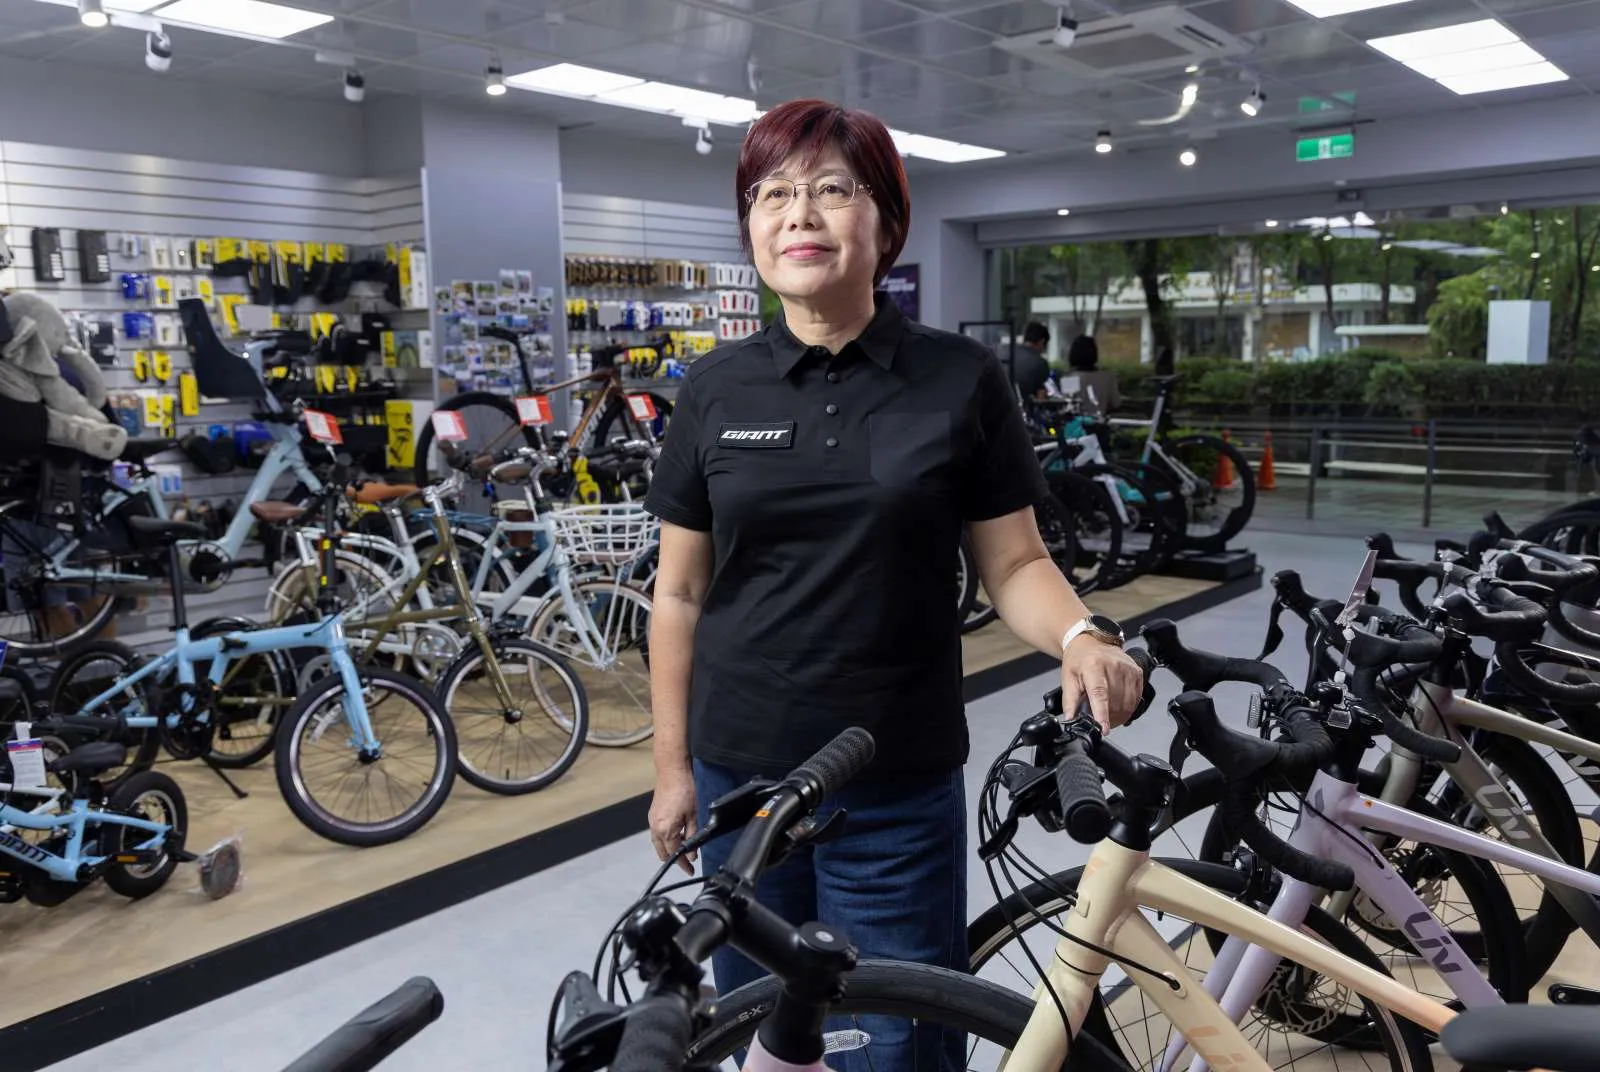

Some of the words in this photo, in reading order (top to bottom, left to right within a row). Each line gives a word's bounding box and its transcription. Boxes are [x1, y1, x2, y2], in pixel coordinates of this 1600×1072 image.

[720, 429, 790, 440] GIANT
[1476, 784, 1532, 840] Liv
[1404, 911, 1464, 974] Liv
[1186, 1025, 1246, 1072] Li
